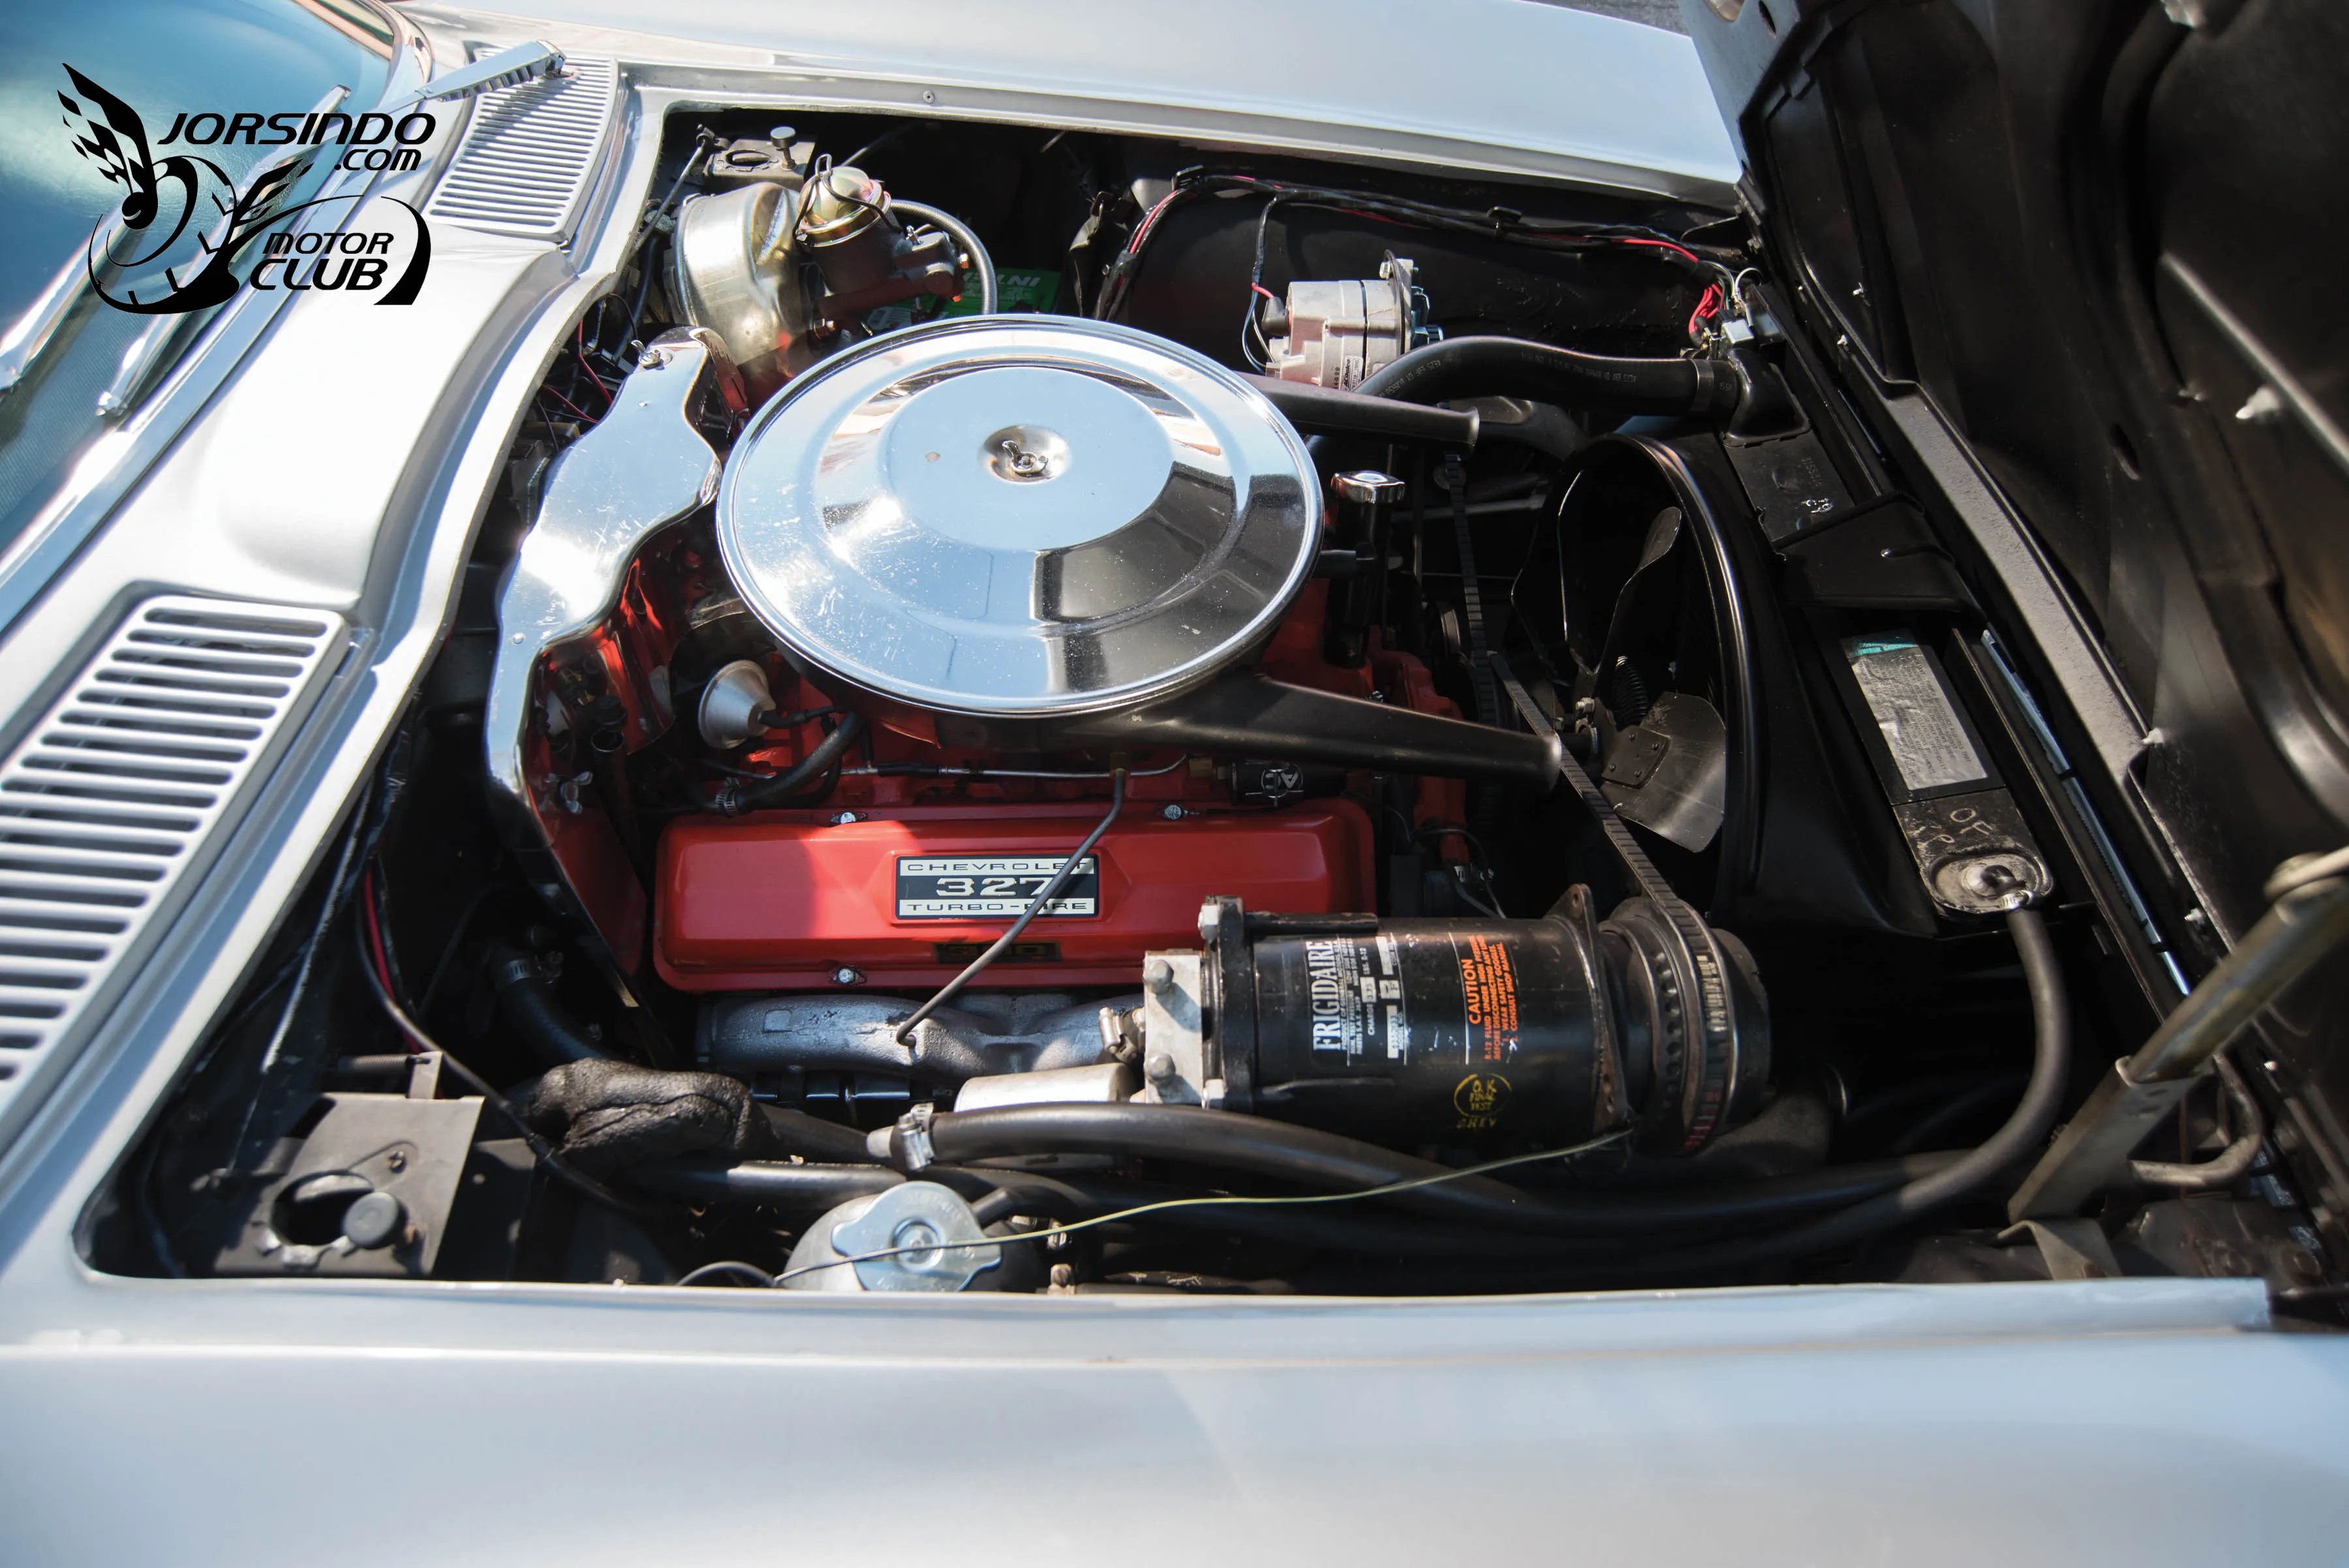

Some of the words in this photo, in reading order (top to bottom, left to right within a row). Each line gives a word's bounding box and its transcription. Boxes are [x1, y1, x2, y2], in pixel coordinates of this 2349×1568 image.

[1265, 772, 1298, 790] AC
[908, 862, 1086, 871] CHEVROLET
[936, 877, 1053, 897] 327
[1483, 951, 1492, 964] ANY
[1477, 964, 1487, 983] HIGH
[1503, 972, 1514, 992] SHOP
[1306, 941, 1341, 1051] FRIGIDAIRE
[1461, 959, 1481, 1024] CAUTION
[1481, 985, 1490, 1012] UNDER
[1486, 966, 1500, 1028] DISCONNECTING
[1496, 978, 1506, 1004] SAFETY
[1366, 1003, 1375, 1036] CHARGE
[1499, 1006, 1509, 1031] WEAR
[1507, 994, 1518, 1031] CONSULT
[1483, 1016, 1492, 1038] FLUID
